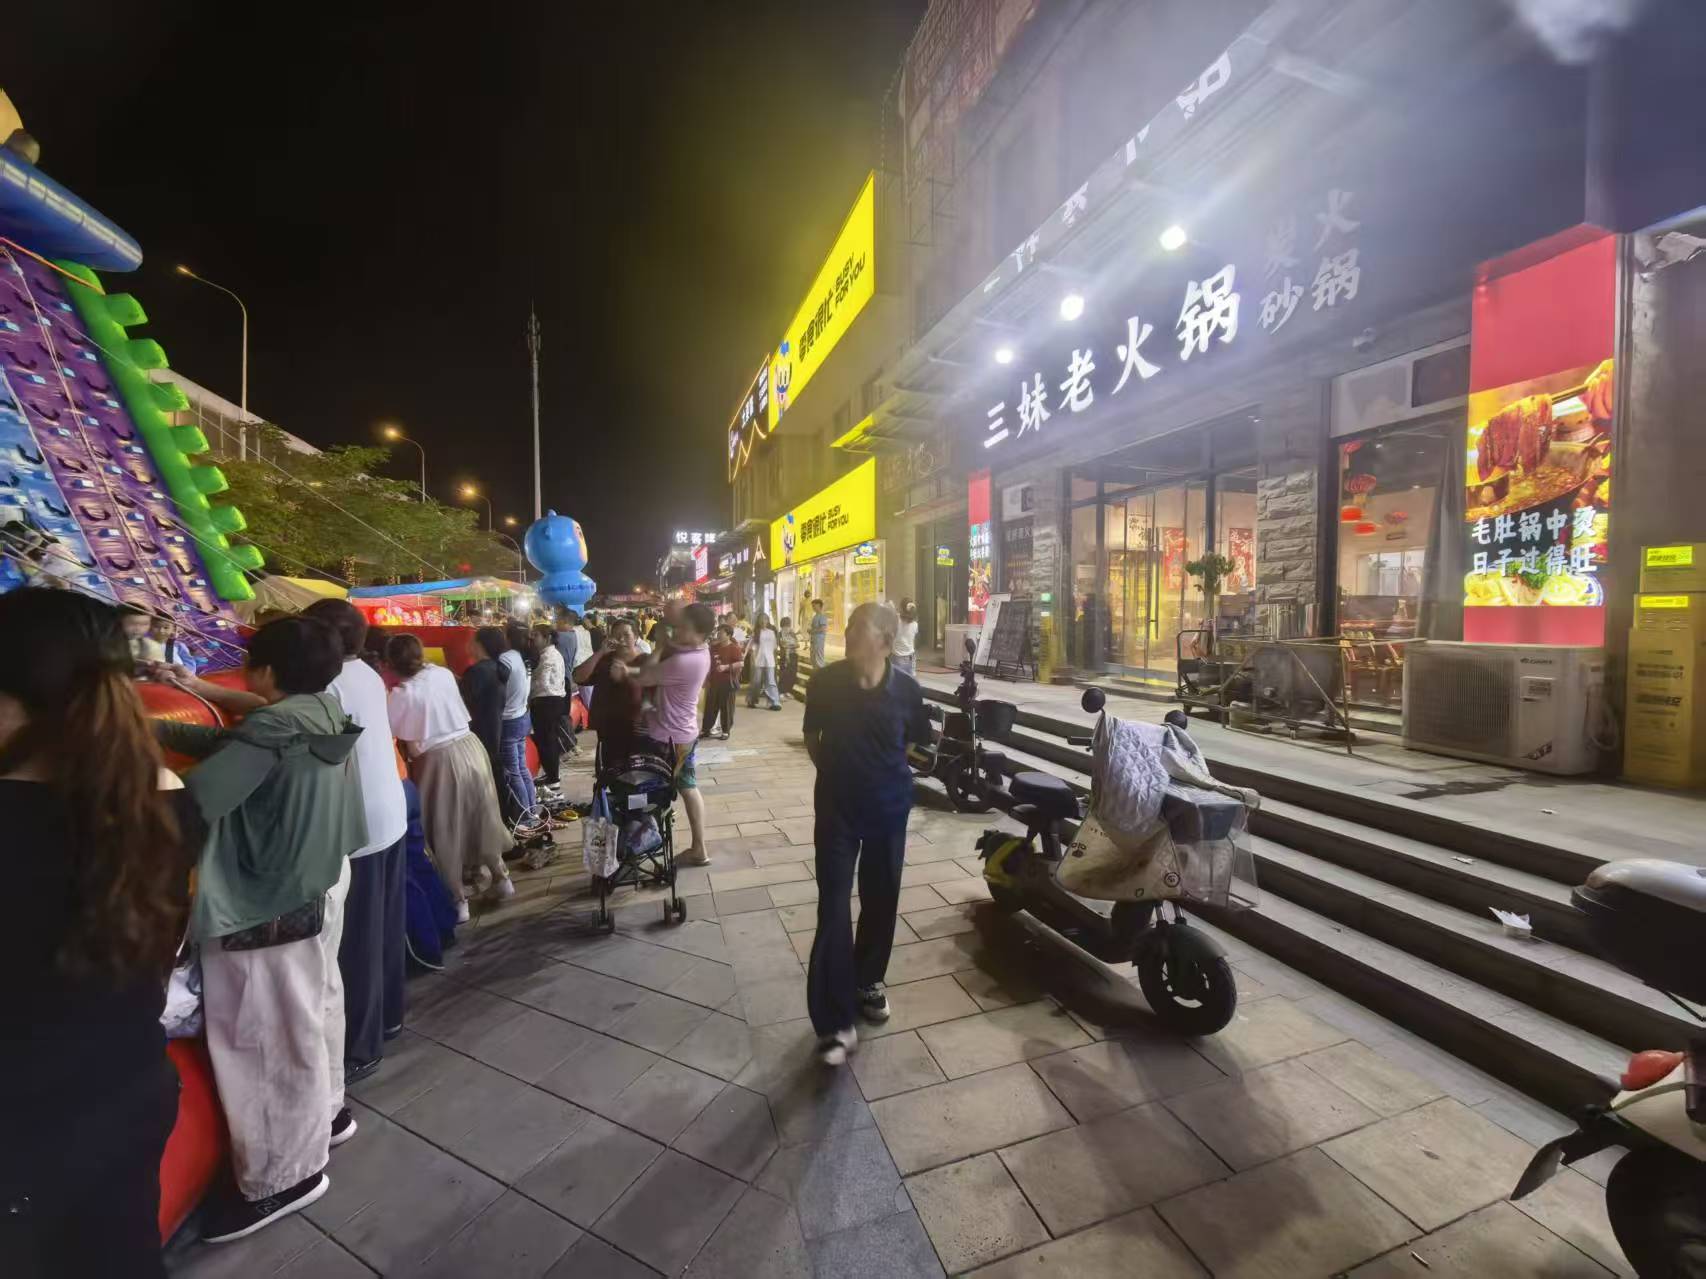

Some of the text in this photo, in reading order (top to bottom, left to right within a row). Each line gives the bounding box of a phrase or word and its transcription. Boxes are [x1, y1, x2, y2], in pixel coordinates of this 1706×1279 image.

[835, 252, 854, 294] BUSY
[835, 252, 866, 309] FOR YOU
[1256, 247, 1361, 336] 砂锅
[799, 287, 834, 363] 零食很忙
[983, 263, 1241, 449] 三妹老火锅
[800, 511, 827, 544] 零食很忙
[1472, 542, 1598, 577] 日子过得旺
